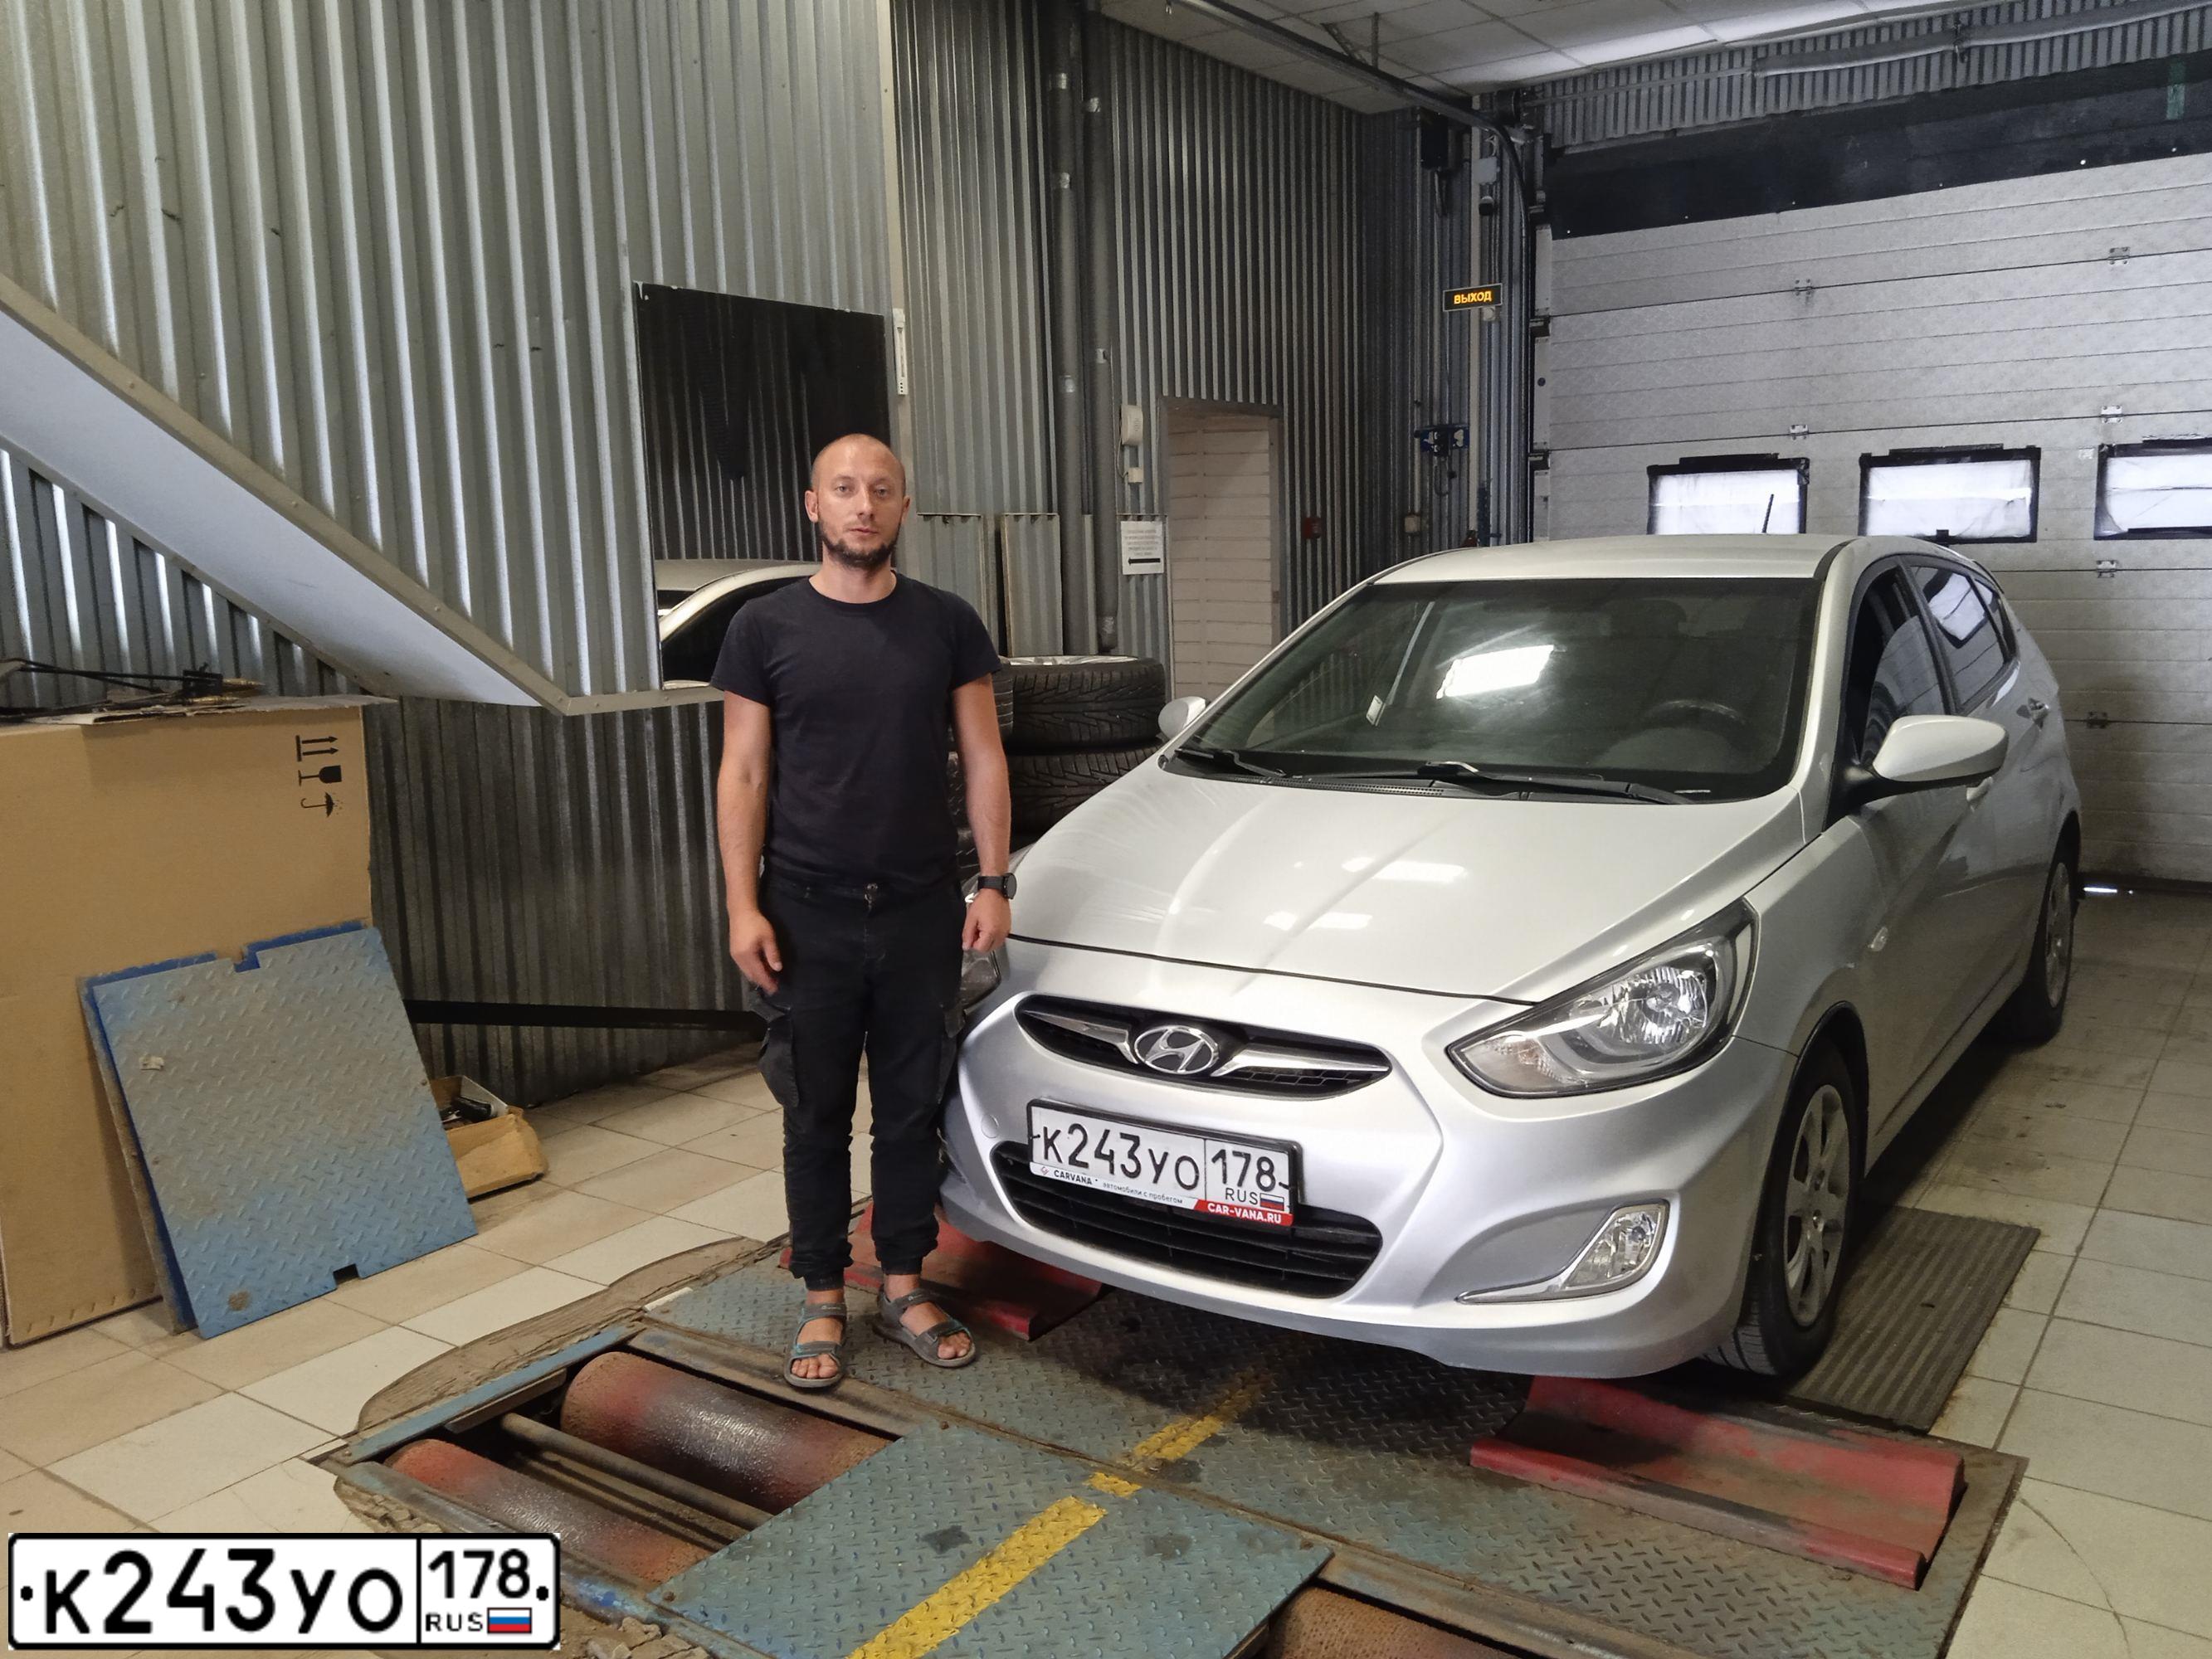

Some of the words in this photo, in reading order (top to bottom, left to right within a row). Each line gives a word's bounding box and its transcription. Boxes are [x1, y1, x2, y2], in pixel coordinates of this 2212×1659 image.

[1454, 290, 1492, 304] ВЫХОД
[1053, 1170, 1093, 1185] CARVANA
[1211, 1148, 1276, 1192] 178
[1102, 1182, 1142, 1196] автомобили
[1149, 1192, 1183, 1204] пробегом
[1225, 1187, 1259, 1205] RUS
[1207, 1203, 1282, 1224] CAR-VANA.RU
